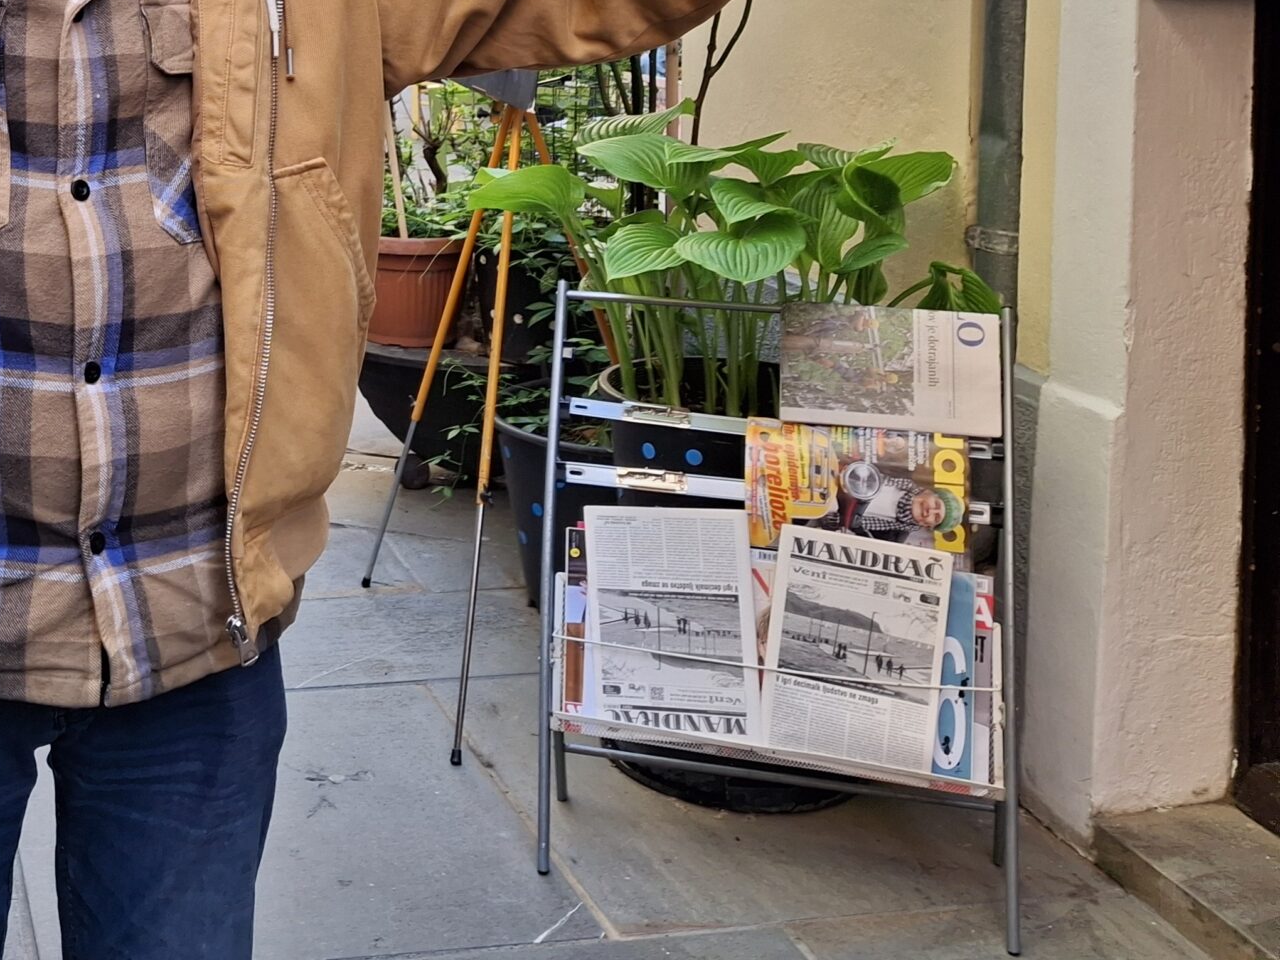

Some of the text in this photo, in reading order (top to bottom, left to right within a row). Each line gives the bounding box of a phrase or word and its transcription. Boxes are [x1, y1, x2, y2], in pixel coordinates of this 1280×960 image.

[925, 336, 939, 388] dotrajanih
[791, 536, 945, 581] MANDRAČ
[781, 676, 792, 687] igri
[793, 678, 821, 692] decimalk
[822, 685, 847, 698] ljudstvo
[858, 694, 879, 705] zmaga
